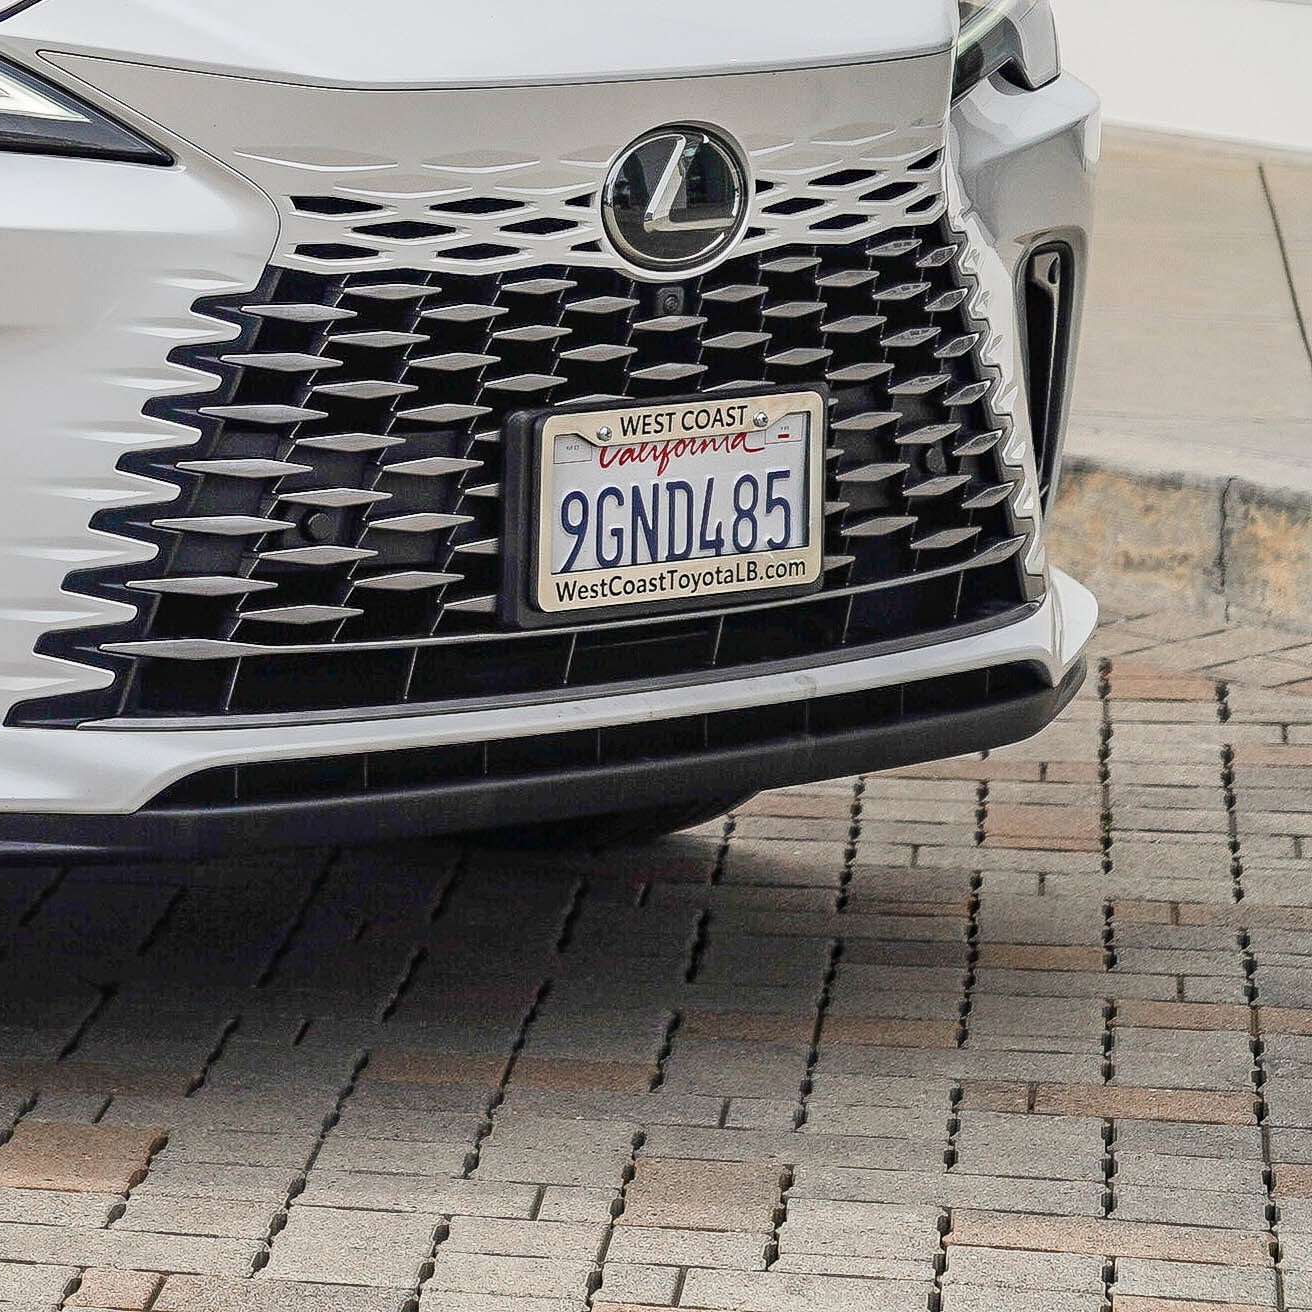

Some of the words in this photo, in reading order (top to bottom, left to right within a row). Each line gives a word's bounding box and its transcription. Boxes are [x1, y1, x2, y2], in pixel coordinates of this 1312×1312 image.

[620, 412, 676, 437] WEST
[681, 405, 748, 431] COAST
[561, 470, 792, 574] 9GND485
[555, 559, 806, 603] WestCoastToyotaLB.com
